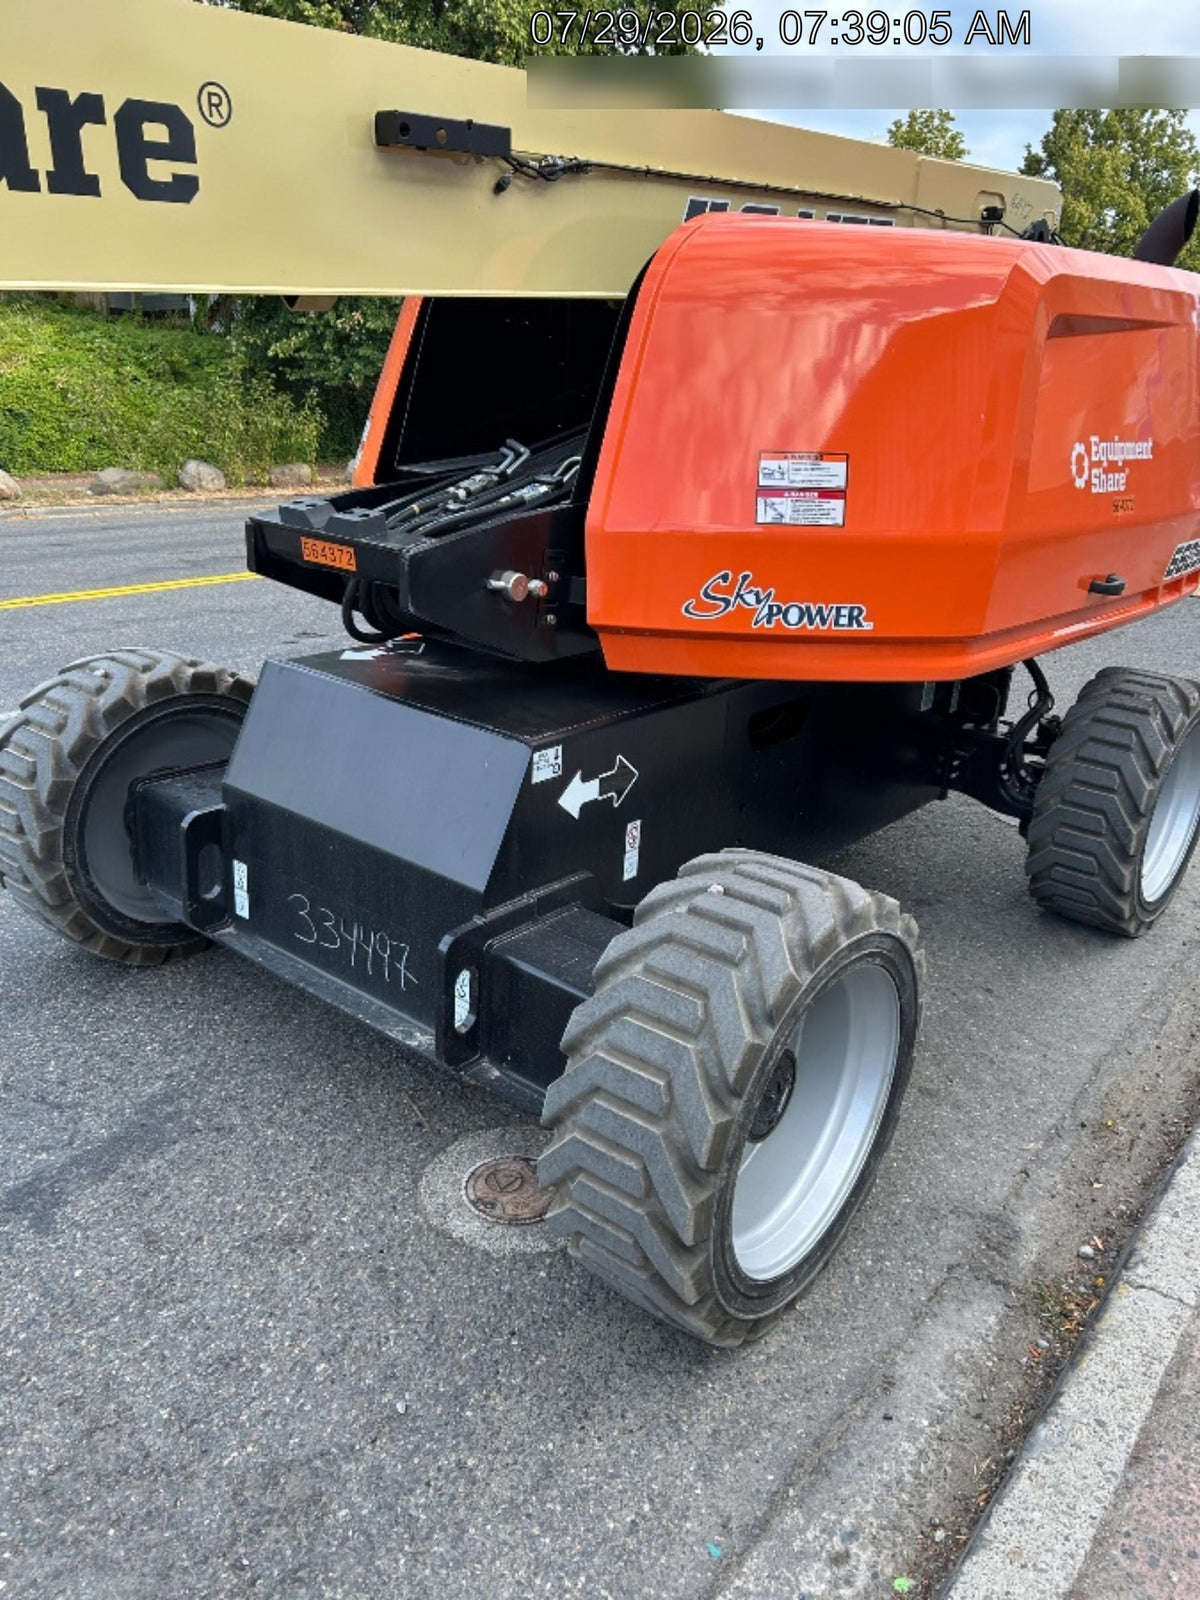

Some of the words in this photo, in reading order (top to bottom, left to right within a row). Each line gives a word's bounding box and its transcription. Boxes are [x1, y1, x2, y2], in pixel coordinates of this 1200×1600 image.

[1090, 435, 1153, 466] Equipment
[303, 541, 354, 567] 564372
[682, 570, 775, 628] Sky
[763, 602, 867, 629] POWER
[288, 893, 419, 991] 334497
